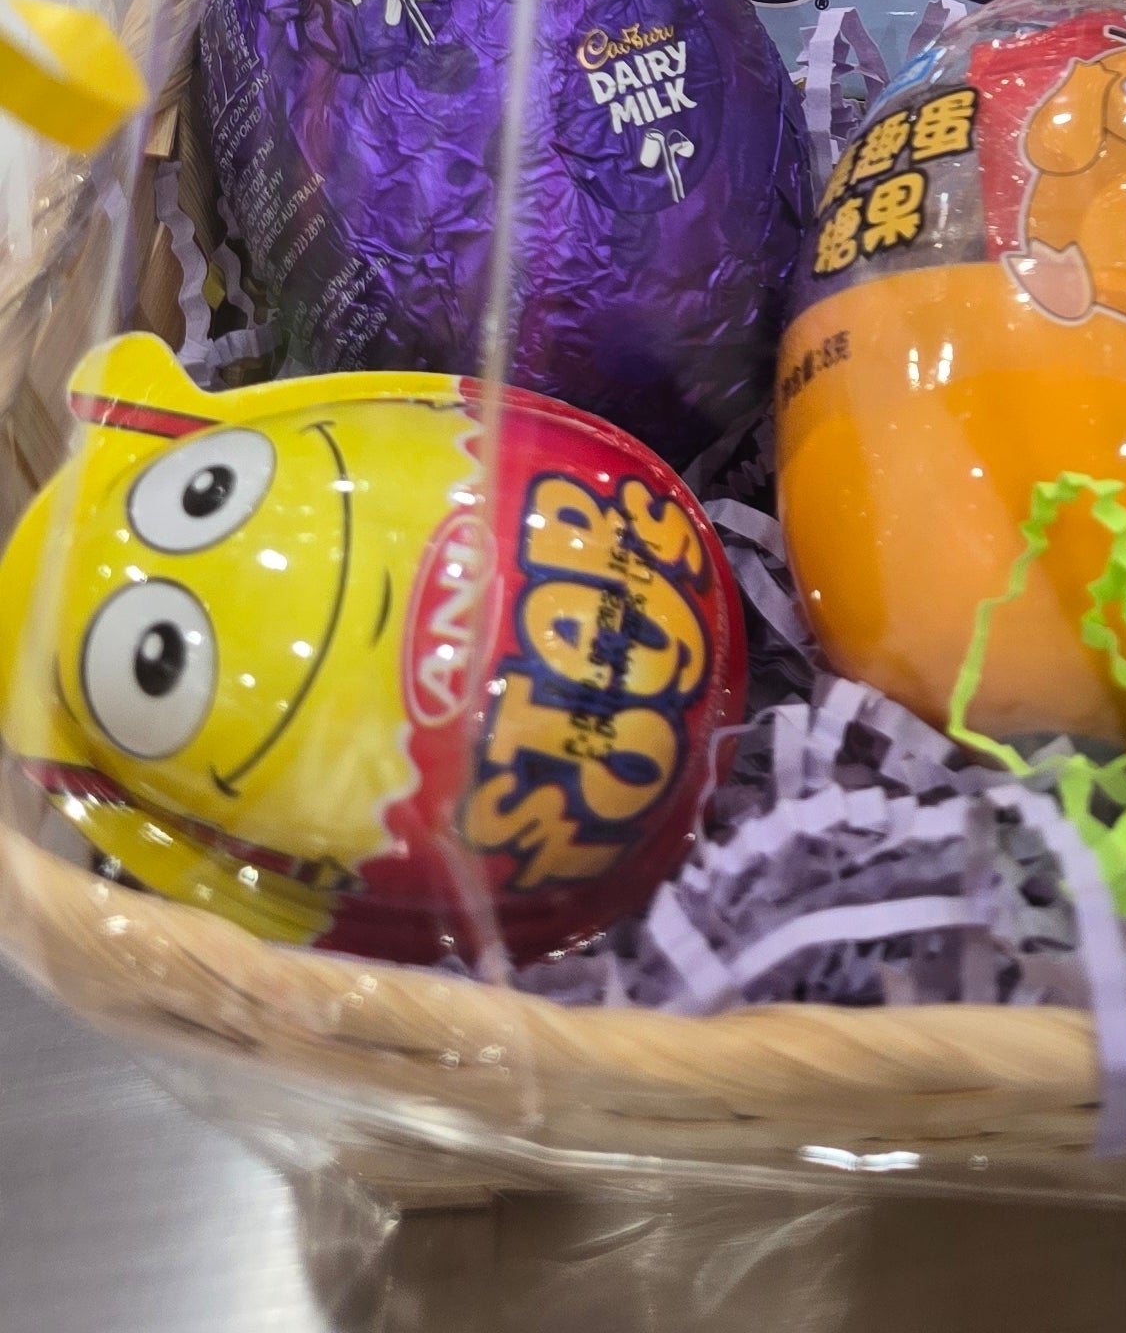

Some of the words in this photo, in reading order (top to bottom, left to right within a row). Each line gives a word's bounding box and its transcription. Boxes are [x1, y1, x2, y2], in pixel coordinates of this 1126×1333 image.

[576, 22, 675, 71] Cadbury
[588, 41, 688, 105] DAIRY
[610, 78, 698, 134] MILK
[266, 167, 284, 193] ANY
[280, 171, 326, 223] AUSTRALIA
[815, 168, 929, 276] 糖果
[318, 256, 362, 305] AUSTRALIA
[420, 540, 486, 710] ANI
[464, 476, 619, 851] STAR
[512, 480, 706, 890] TOYS
